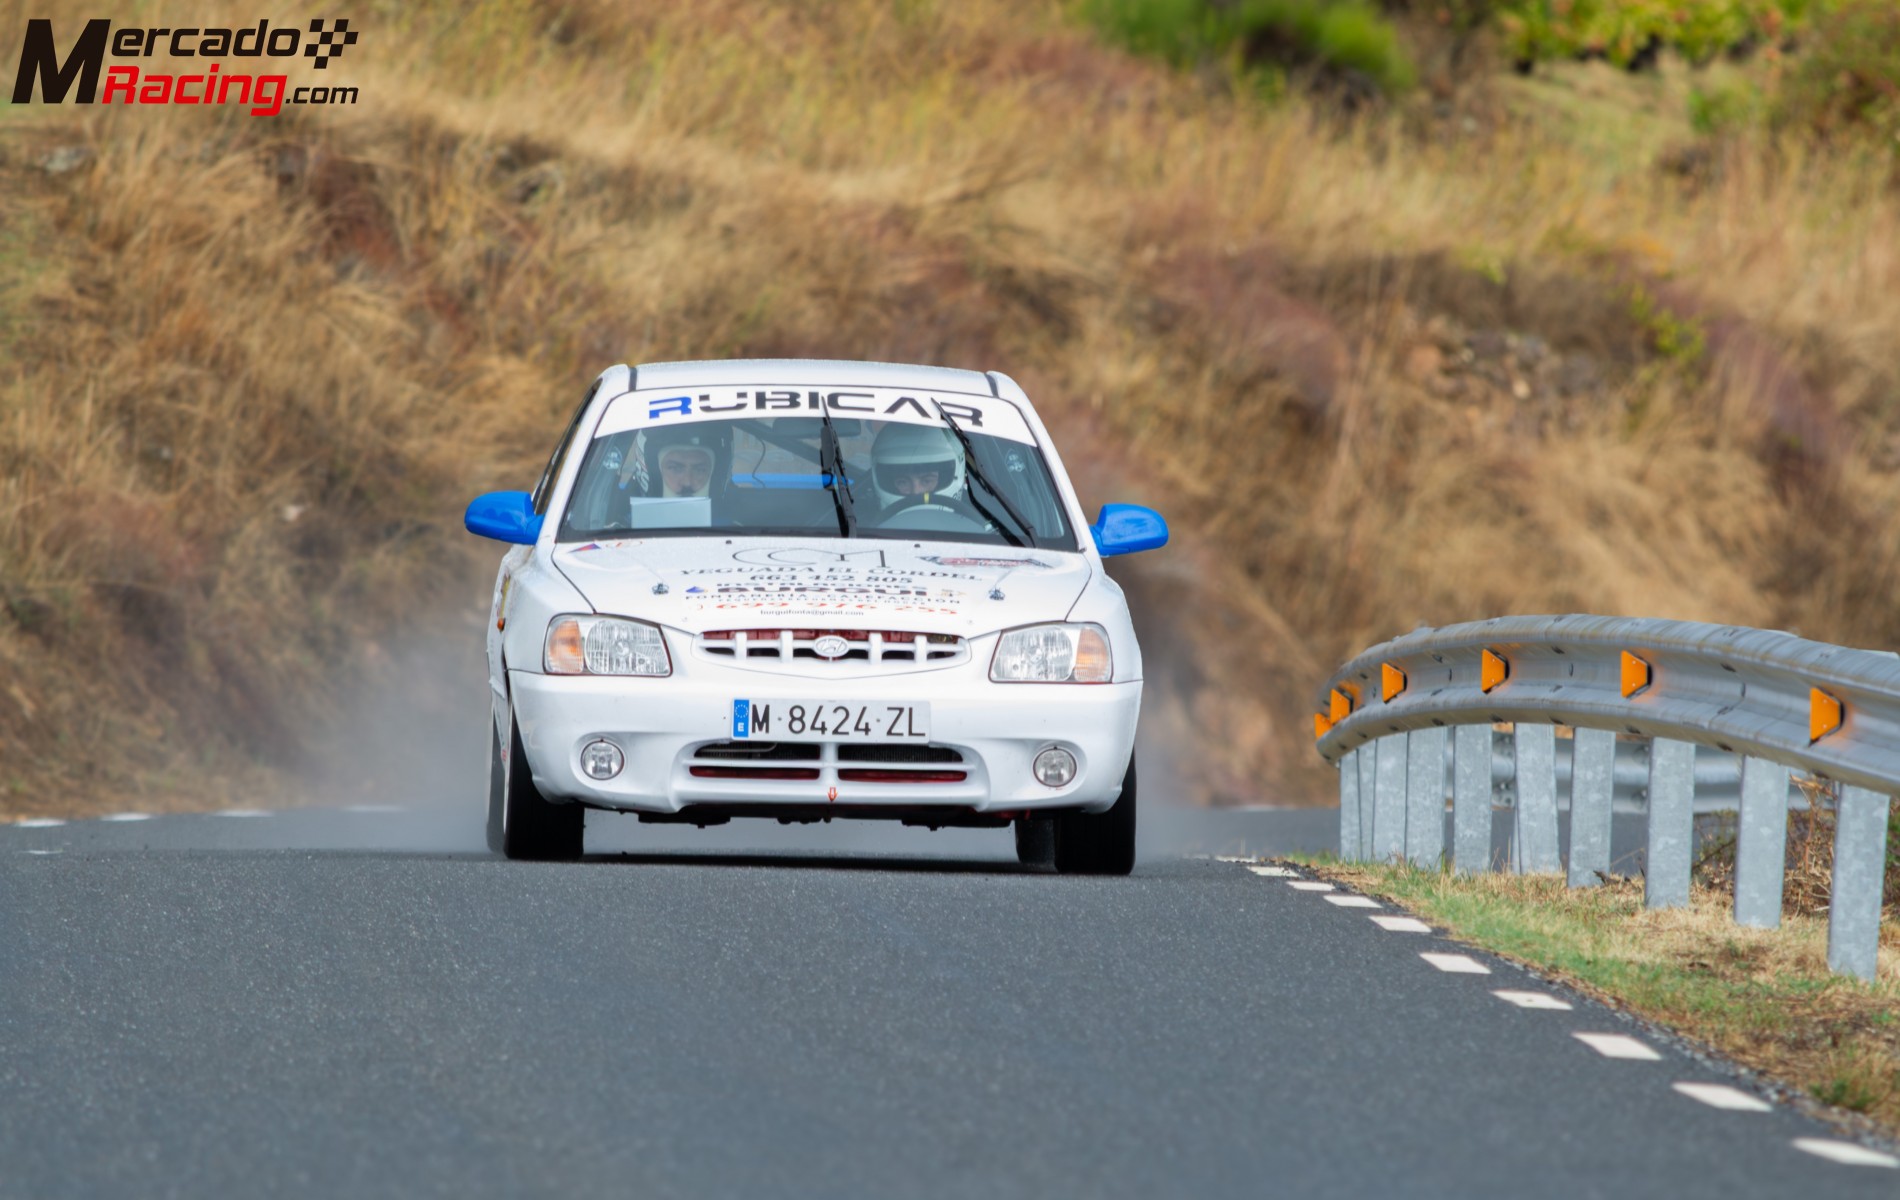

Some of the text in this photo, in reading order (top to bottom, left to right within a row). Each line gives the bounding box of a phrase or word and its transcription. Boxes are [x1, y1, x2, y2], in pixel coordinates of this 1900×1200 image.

[648, 391, 984, 428] RUBICAR
[681, 567, 815, 575] YEGUADA
[868, 568, 982, 580] CORDEL
[737, 722, 745, 732] E
